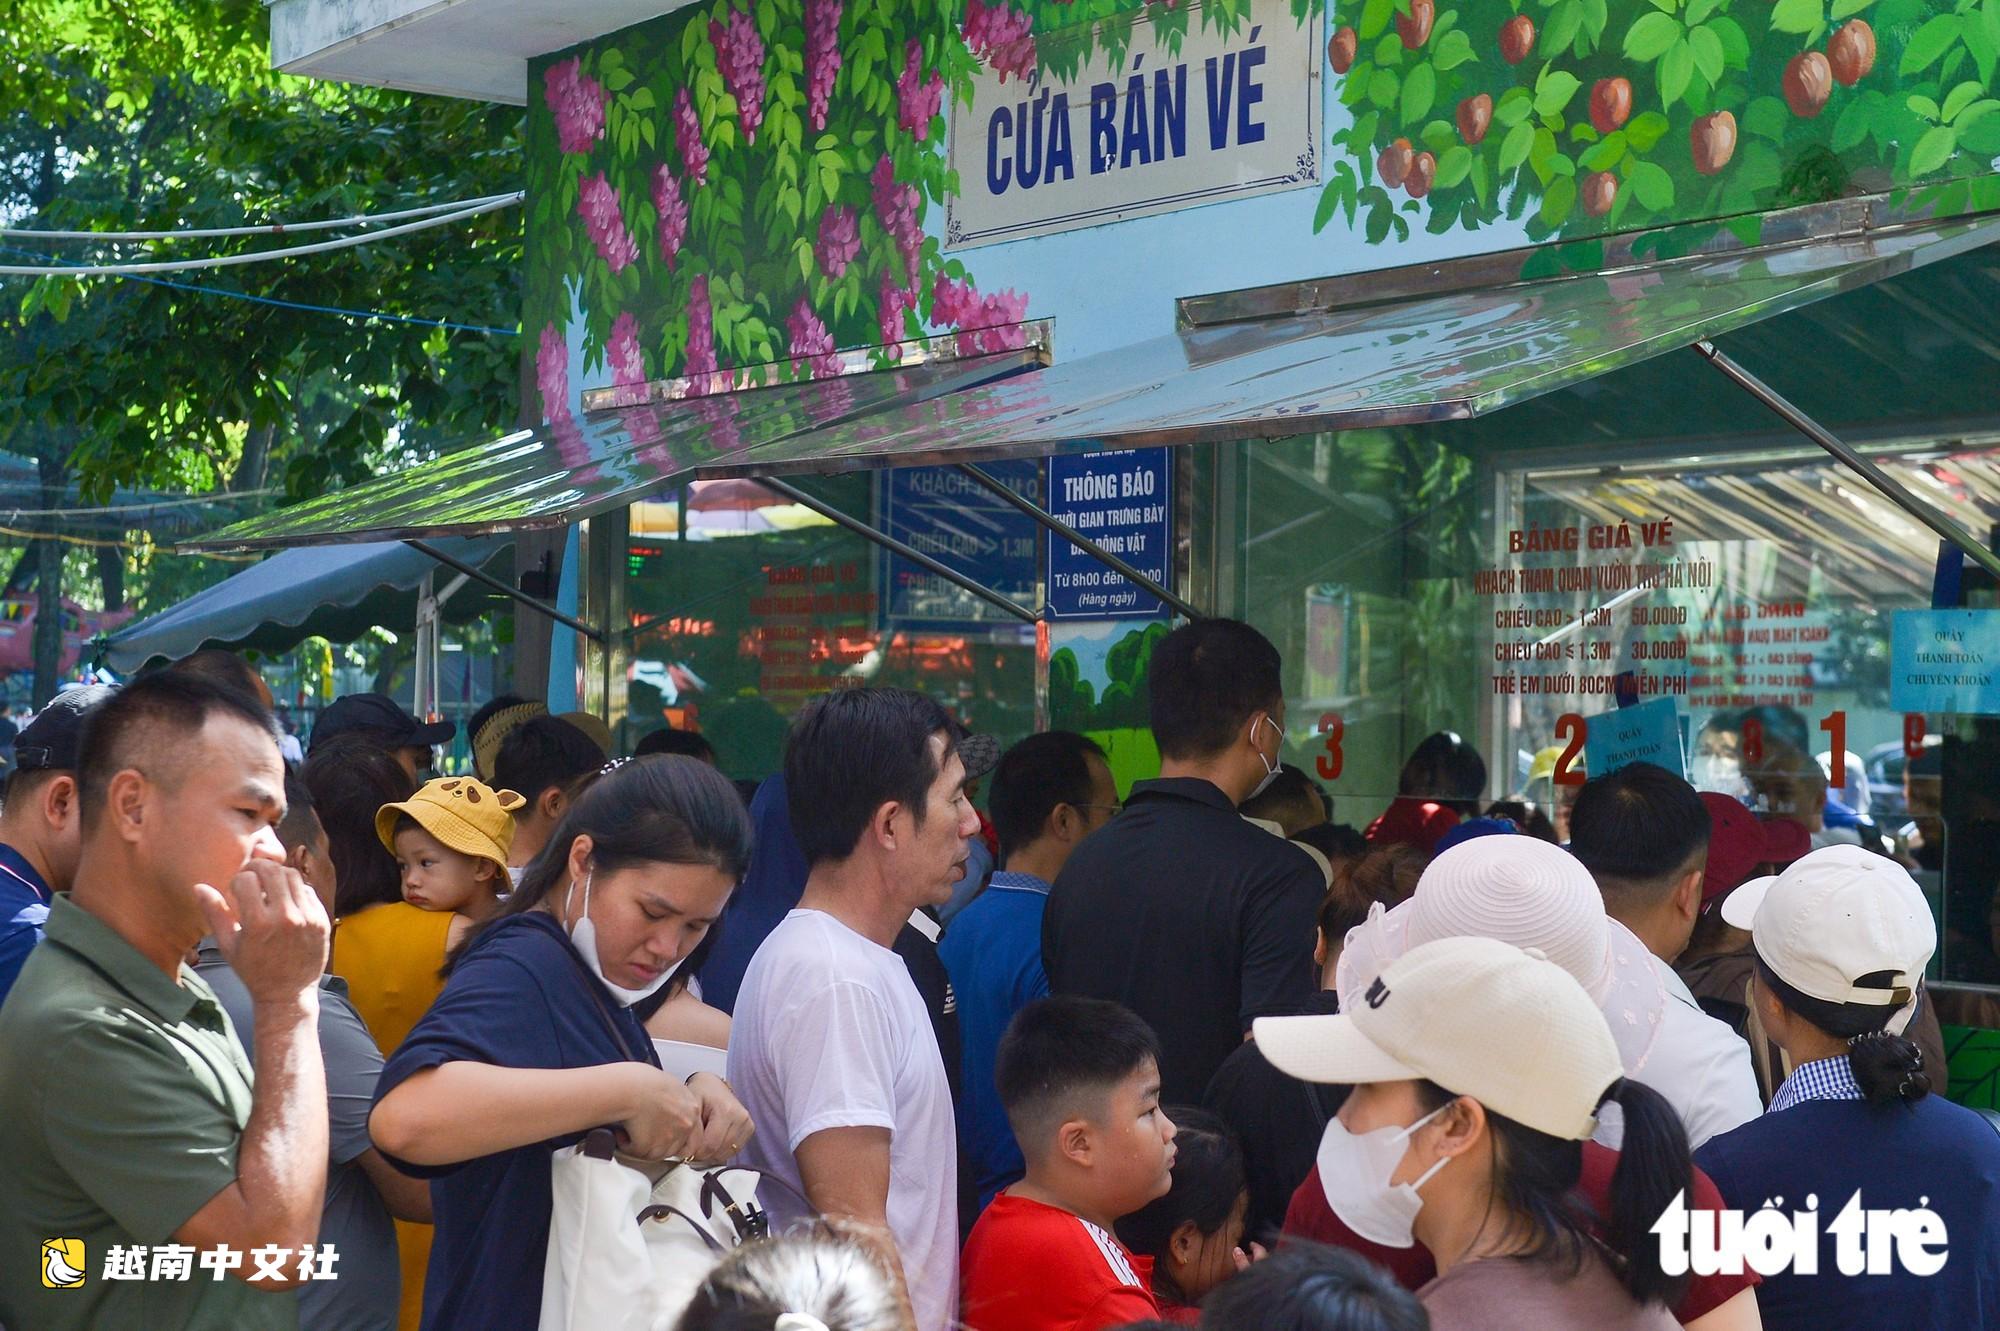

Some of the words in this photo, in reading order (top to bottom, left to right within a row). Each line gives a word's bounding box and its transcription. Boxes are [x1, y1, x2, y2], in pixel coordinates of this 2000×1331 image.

[986, 69, 1074, 196] CỬA
[1089, 53, 1187, 175] BÁN
[1204, 24, 1267, 151] VÉ
[1063, 470, 1117, 502] THÔNG
[1122, 465, 1155, 497] BÁO
[1079, 510, 1104, 528] GIAN
[1106, 506, 1141, 526] TRƯNG
[1143, 503, 1165, 523] BÀY
[1126, 532, 1146, 555] VẬT
[1509, 521, 1578, 553] BẢNG
[1588, 517, 1632, 550] GIÁ
[1641, 516, 1674, 547] VÉ
[1054, 573, 1071, 588] Từ
[1072, 572, 1100, 586] 8h00
[1474, 563, 1515, 595] KHÁCH
[1520, 567, 1554, 594] THAM
[1558, 564, 1592, 593] QUAN
[1597, 558, 1632, 592] VƯỜN
[1665, 557, 1682, 588] HÀ
[1688, 556, 1712, 593] NỘI
[1078, 592, 1107, 608] (Hàng
[1109, 592, 1137, 606] ngày)
[1535, 608, 1562, 627] CAO
[1579, 607, 1612, 627] 1.3M
[1535, 641, 1561, 660] CAO
[1579, 640, 1611, 660] 1.3M
[1916, 653, 1952, 665] THANH
[1492, 670, 1515, 694] TRẺ
[1520, 675, 1539, 694] EM
[1544, 672, 1575, 694] DƯỚI
[1579, 675, 1616, 694] 80CM
[1663, 671, 1687, 694] PHÍ
[1315, 712, 1344, 780] 3
[1553, 712, 1588, 786] 2
[1820, 710, 1846, 789] 1
